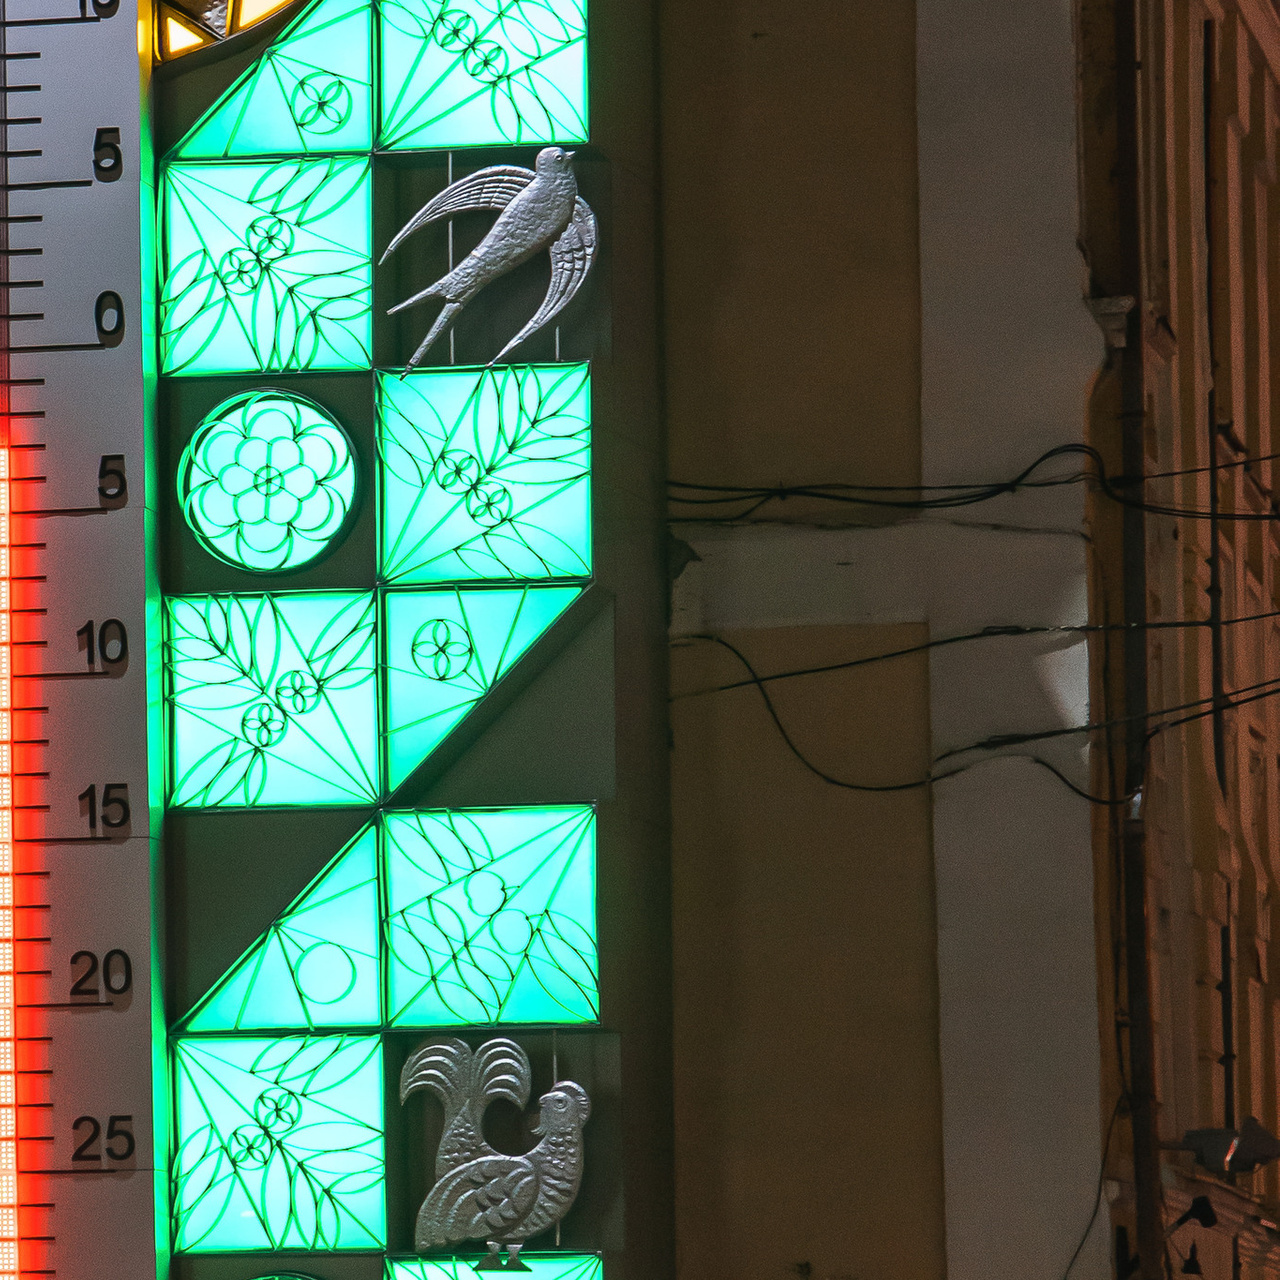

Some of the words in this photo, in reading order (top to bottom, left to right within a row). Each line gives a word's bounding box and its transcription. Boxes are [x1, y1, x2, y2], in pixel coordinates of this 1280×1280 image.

[94, 127, 121, 177] 5
[96, 291, 122, 338] 0
[99, 455, 125, 498] 5
[77, 619, 127, 667] 10
[78, 783, 129, 830] 15
[70, 949, 132, 996] 20
[71, 1117, 135, 1161] 25
